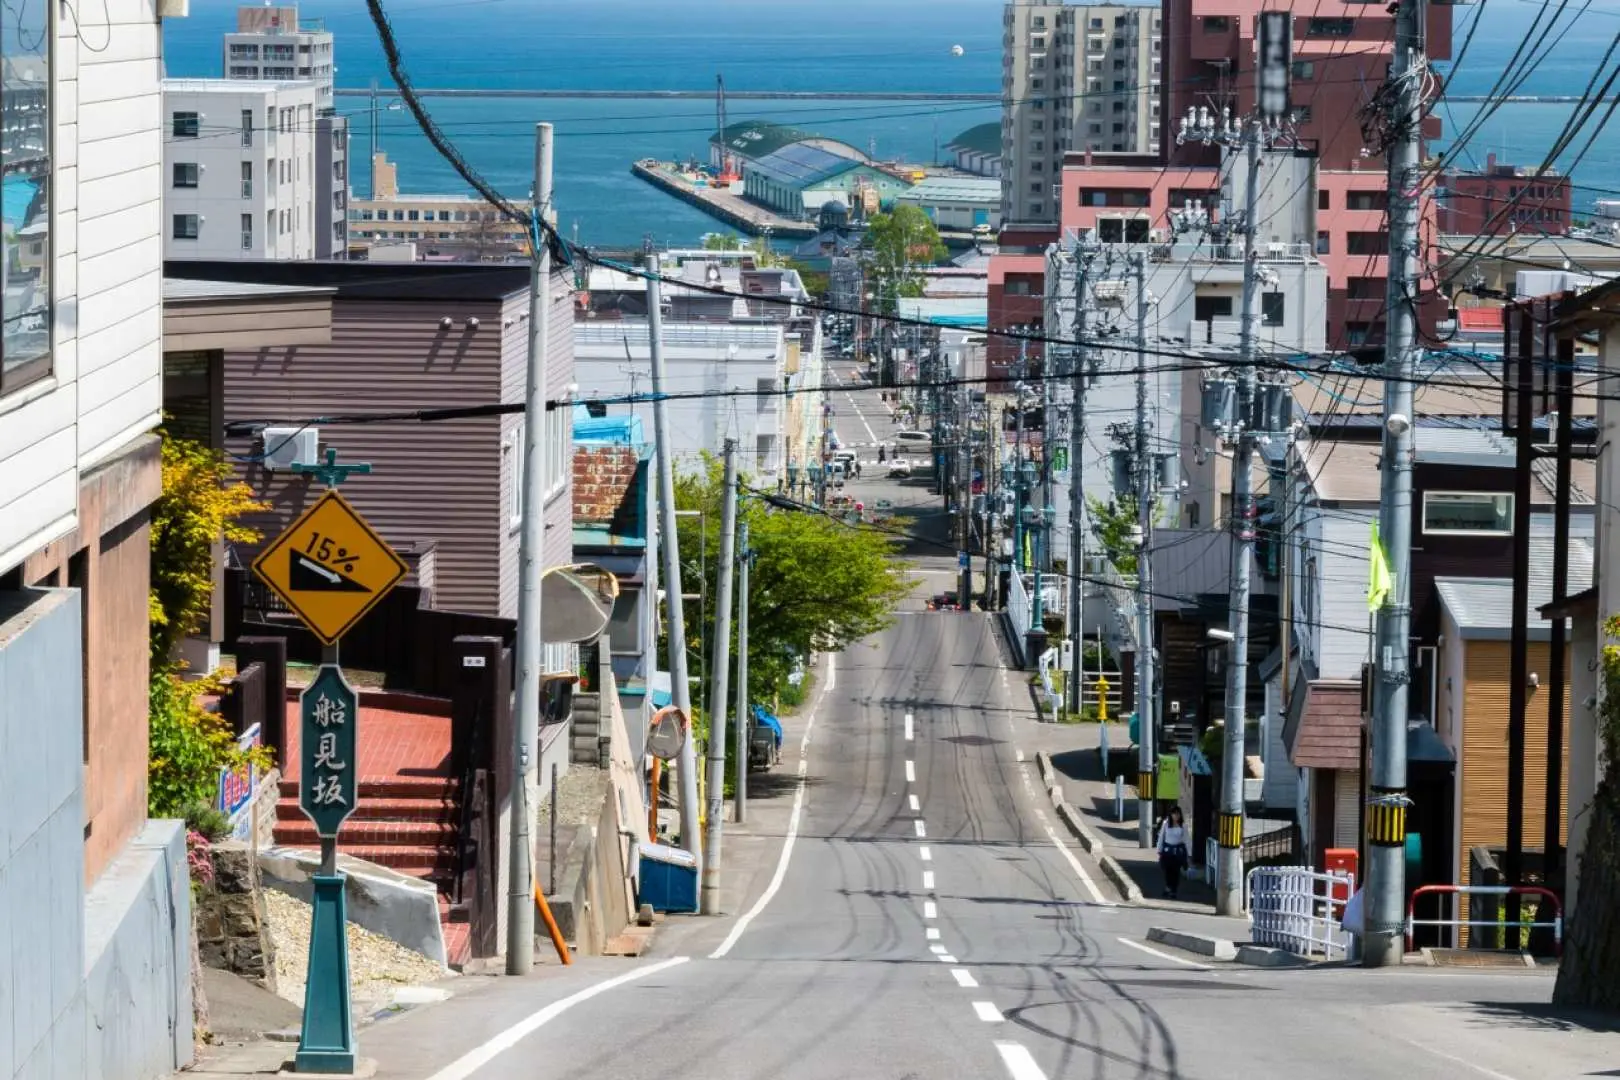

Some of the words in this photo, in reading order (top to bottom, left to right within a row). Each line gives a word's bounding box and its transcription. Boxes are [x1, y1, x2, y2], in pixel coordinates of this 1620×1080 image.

[305, 531, 360, 573] 15%
[312, 693, 347, 806] 船見坂
